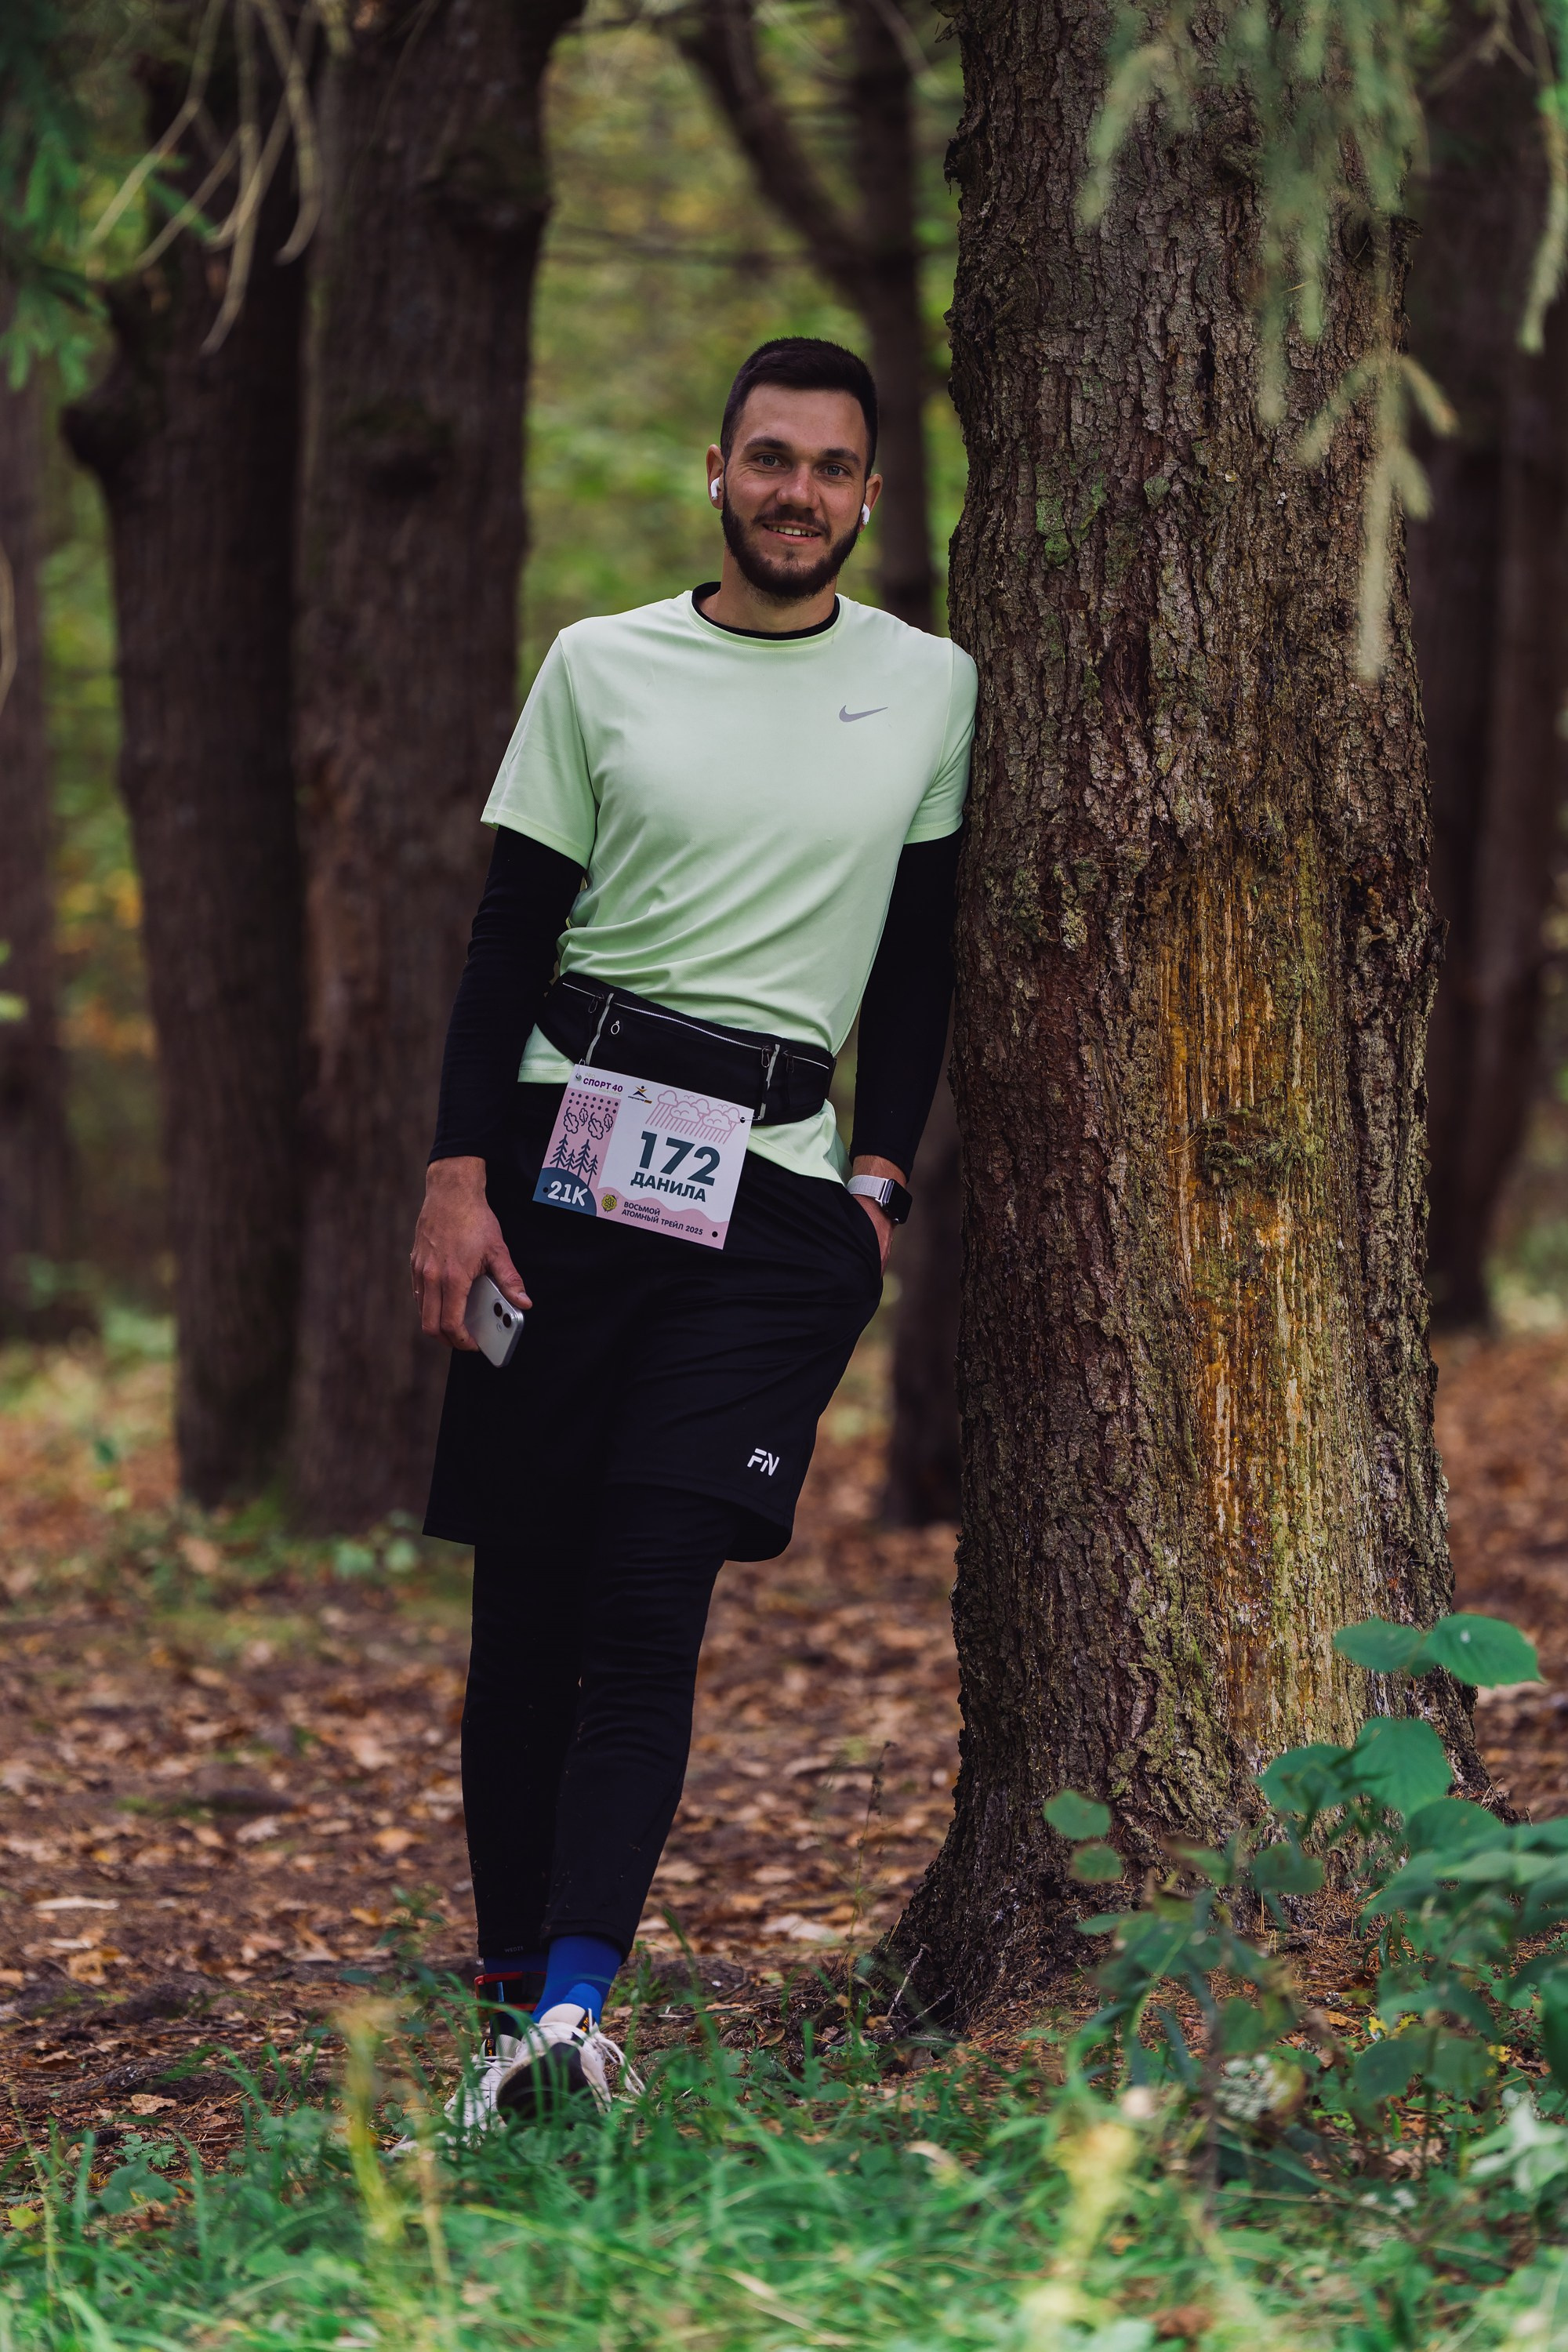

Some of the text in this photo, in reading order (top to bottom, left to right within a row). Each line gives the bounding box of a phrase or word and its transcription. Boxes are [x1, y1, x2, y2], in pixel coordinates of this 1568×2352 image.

[583, 1078, 612, 1090] СПОРТ
[640, 1131, 720, 1186] 172
[630, 1171, 706, 1202] ДАНИЛА
[623, 1201, 660, 1216] ВОСЬМОЙ
[621, 1209, 703, 1236] АТОМНЫЙ ТРЕЙЛ 2025
